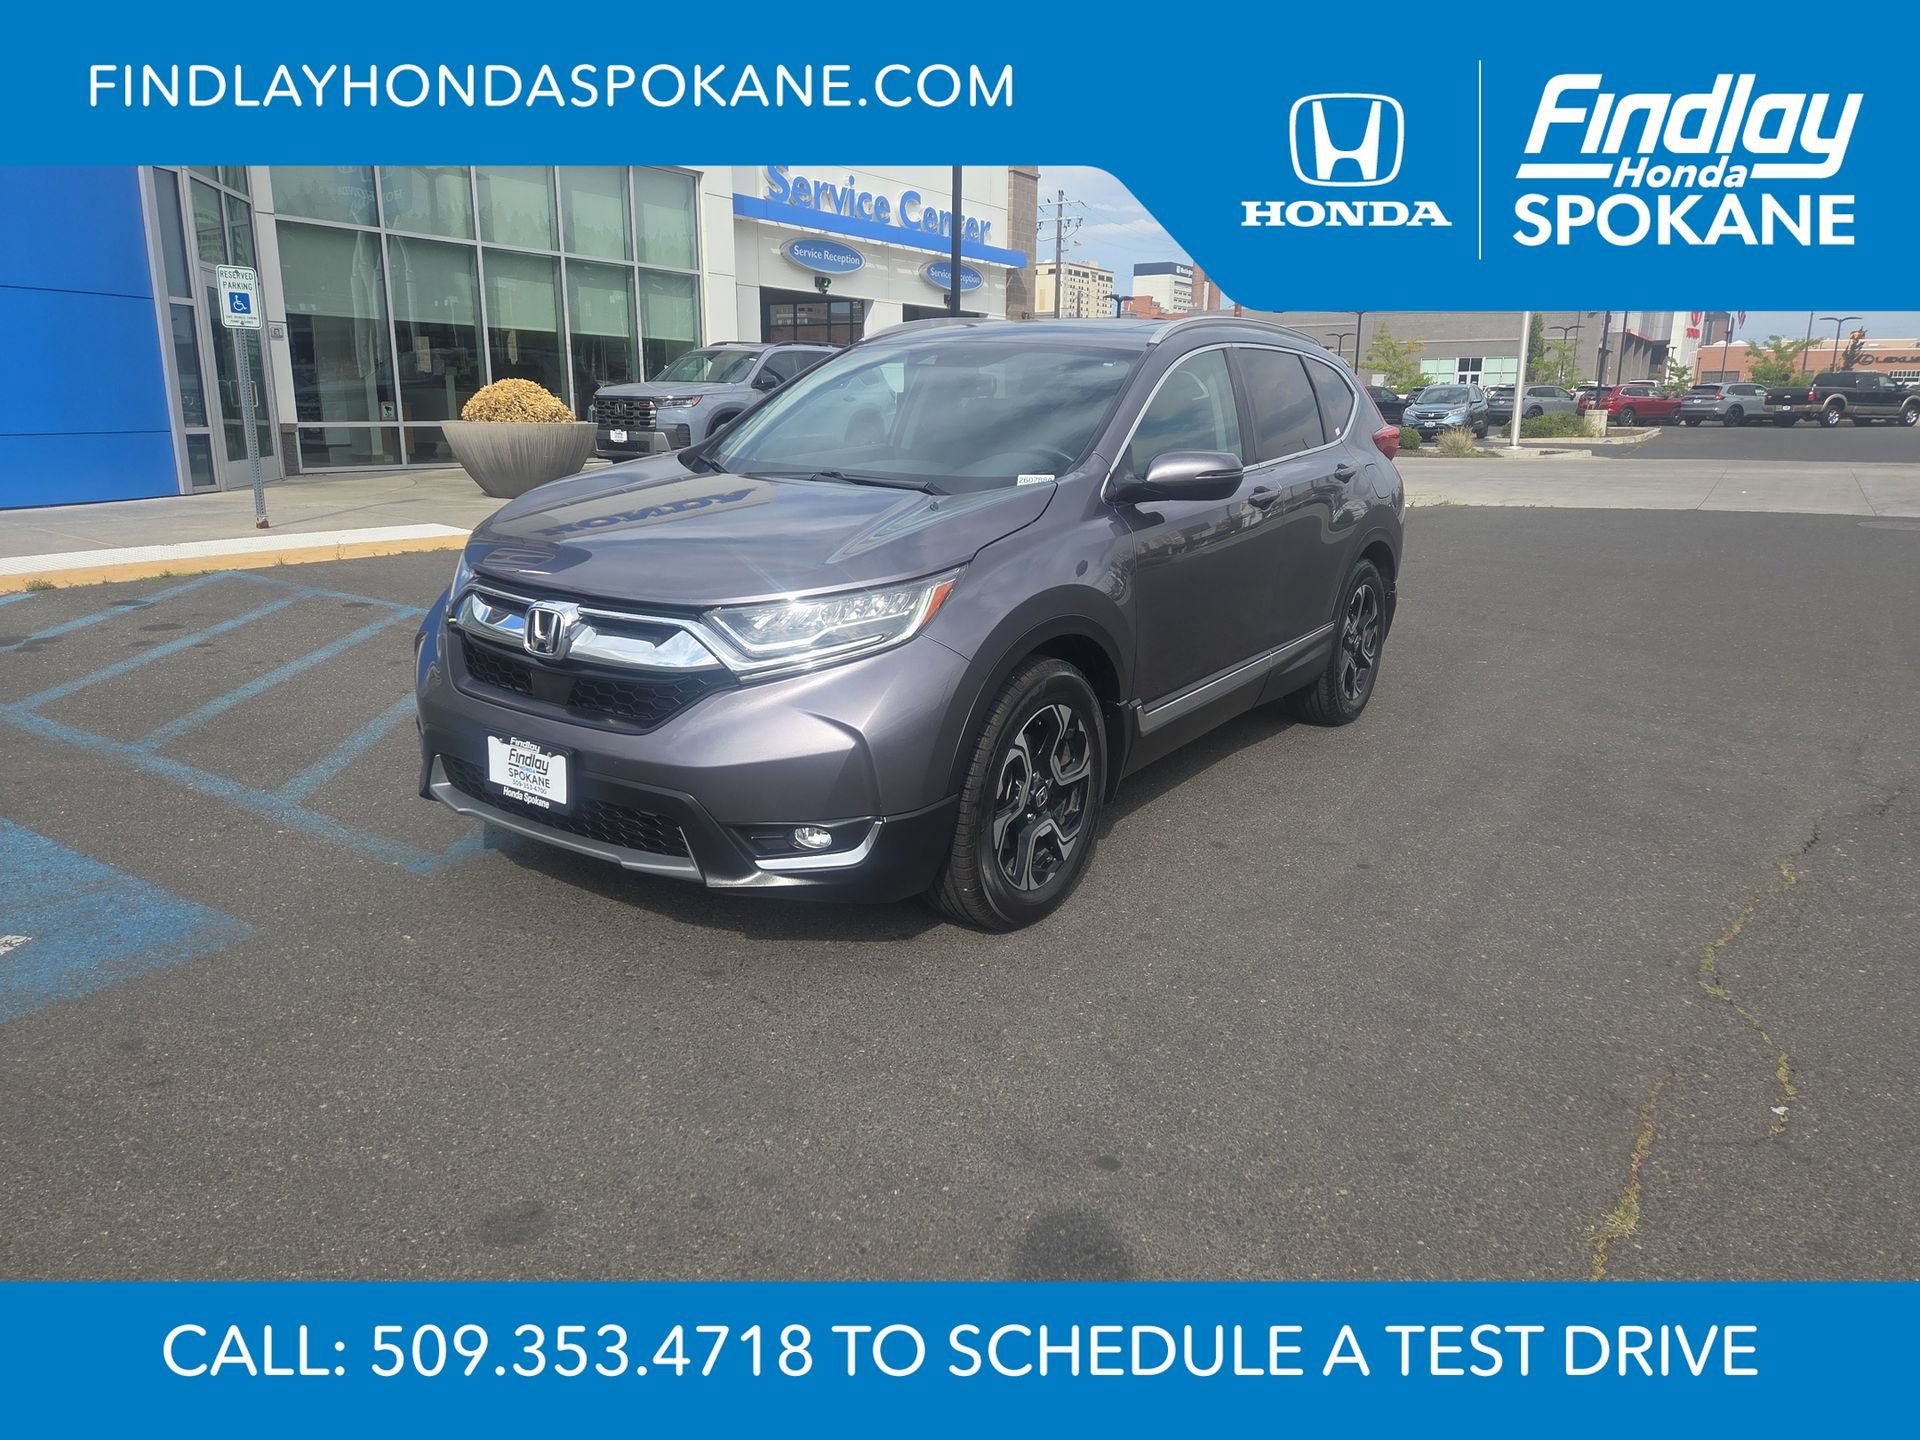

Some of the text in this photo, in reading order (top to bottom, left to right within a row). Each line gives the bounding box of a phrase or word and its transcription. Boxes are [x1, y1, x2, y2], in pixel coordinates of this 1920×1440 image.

[764, 166, 992, 243] Service Cener
[793, 245, 860, 265] Service Reception
[220, 270, 253, 280] RESERVED
[930, 267, 952, 281] Service
[223, 282, 253, 290] PARKING
[510, 737, 540, 753] Findlay
[508, 749, 549, 775] Findlay
[508, 767, 550, 788] SPOKANE
[503, 786, 550, 809] Honda Spokane
